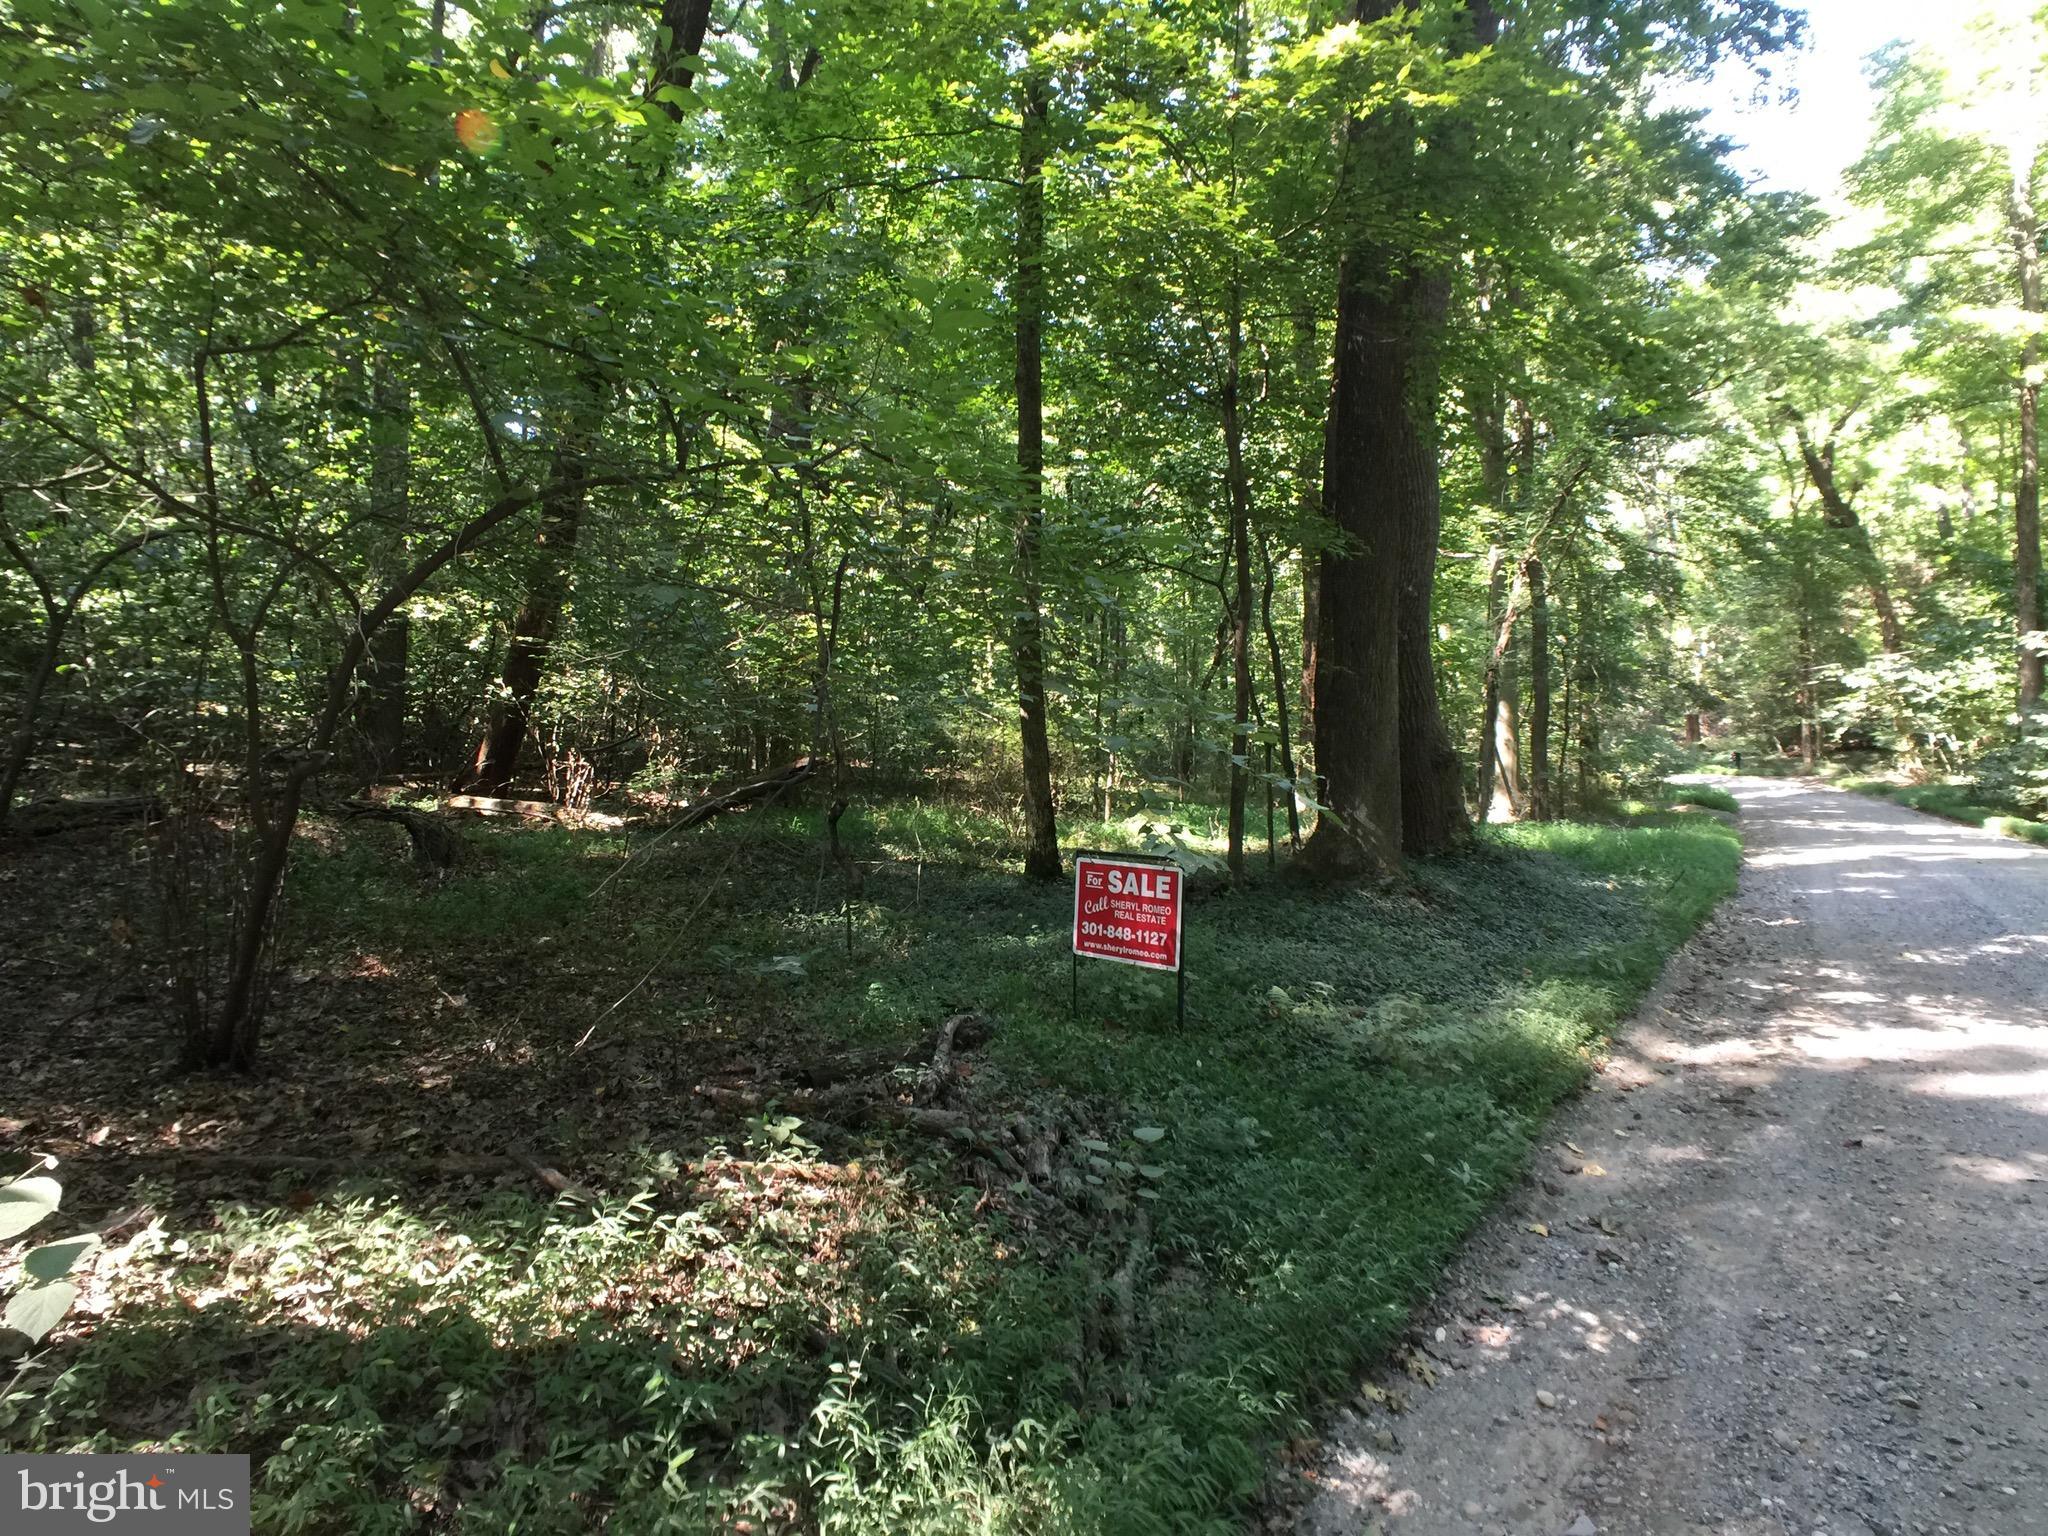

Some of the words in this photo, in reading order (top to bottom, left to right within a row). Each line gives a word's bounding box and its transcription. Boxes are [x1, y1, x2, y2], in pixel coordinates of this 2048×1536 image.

[1086, 874, 1103, 886] For
[1107, 870, 1171, 900] SALE
[1084, 895, 1109, 914] Call
[1111, 900, 1140, 912] SHERYL
[1142, 904, 1171, 916] ROMEO
[1114, 911, 1134, 921] REAL
[1136, 913, 1166, 925] ESTATE
[1081, 921, 1167, 946] 301-848-1127
[1083, 941, 1167, 960] www.sherylromeo.com
